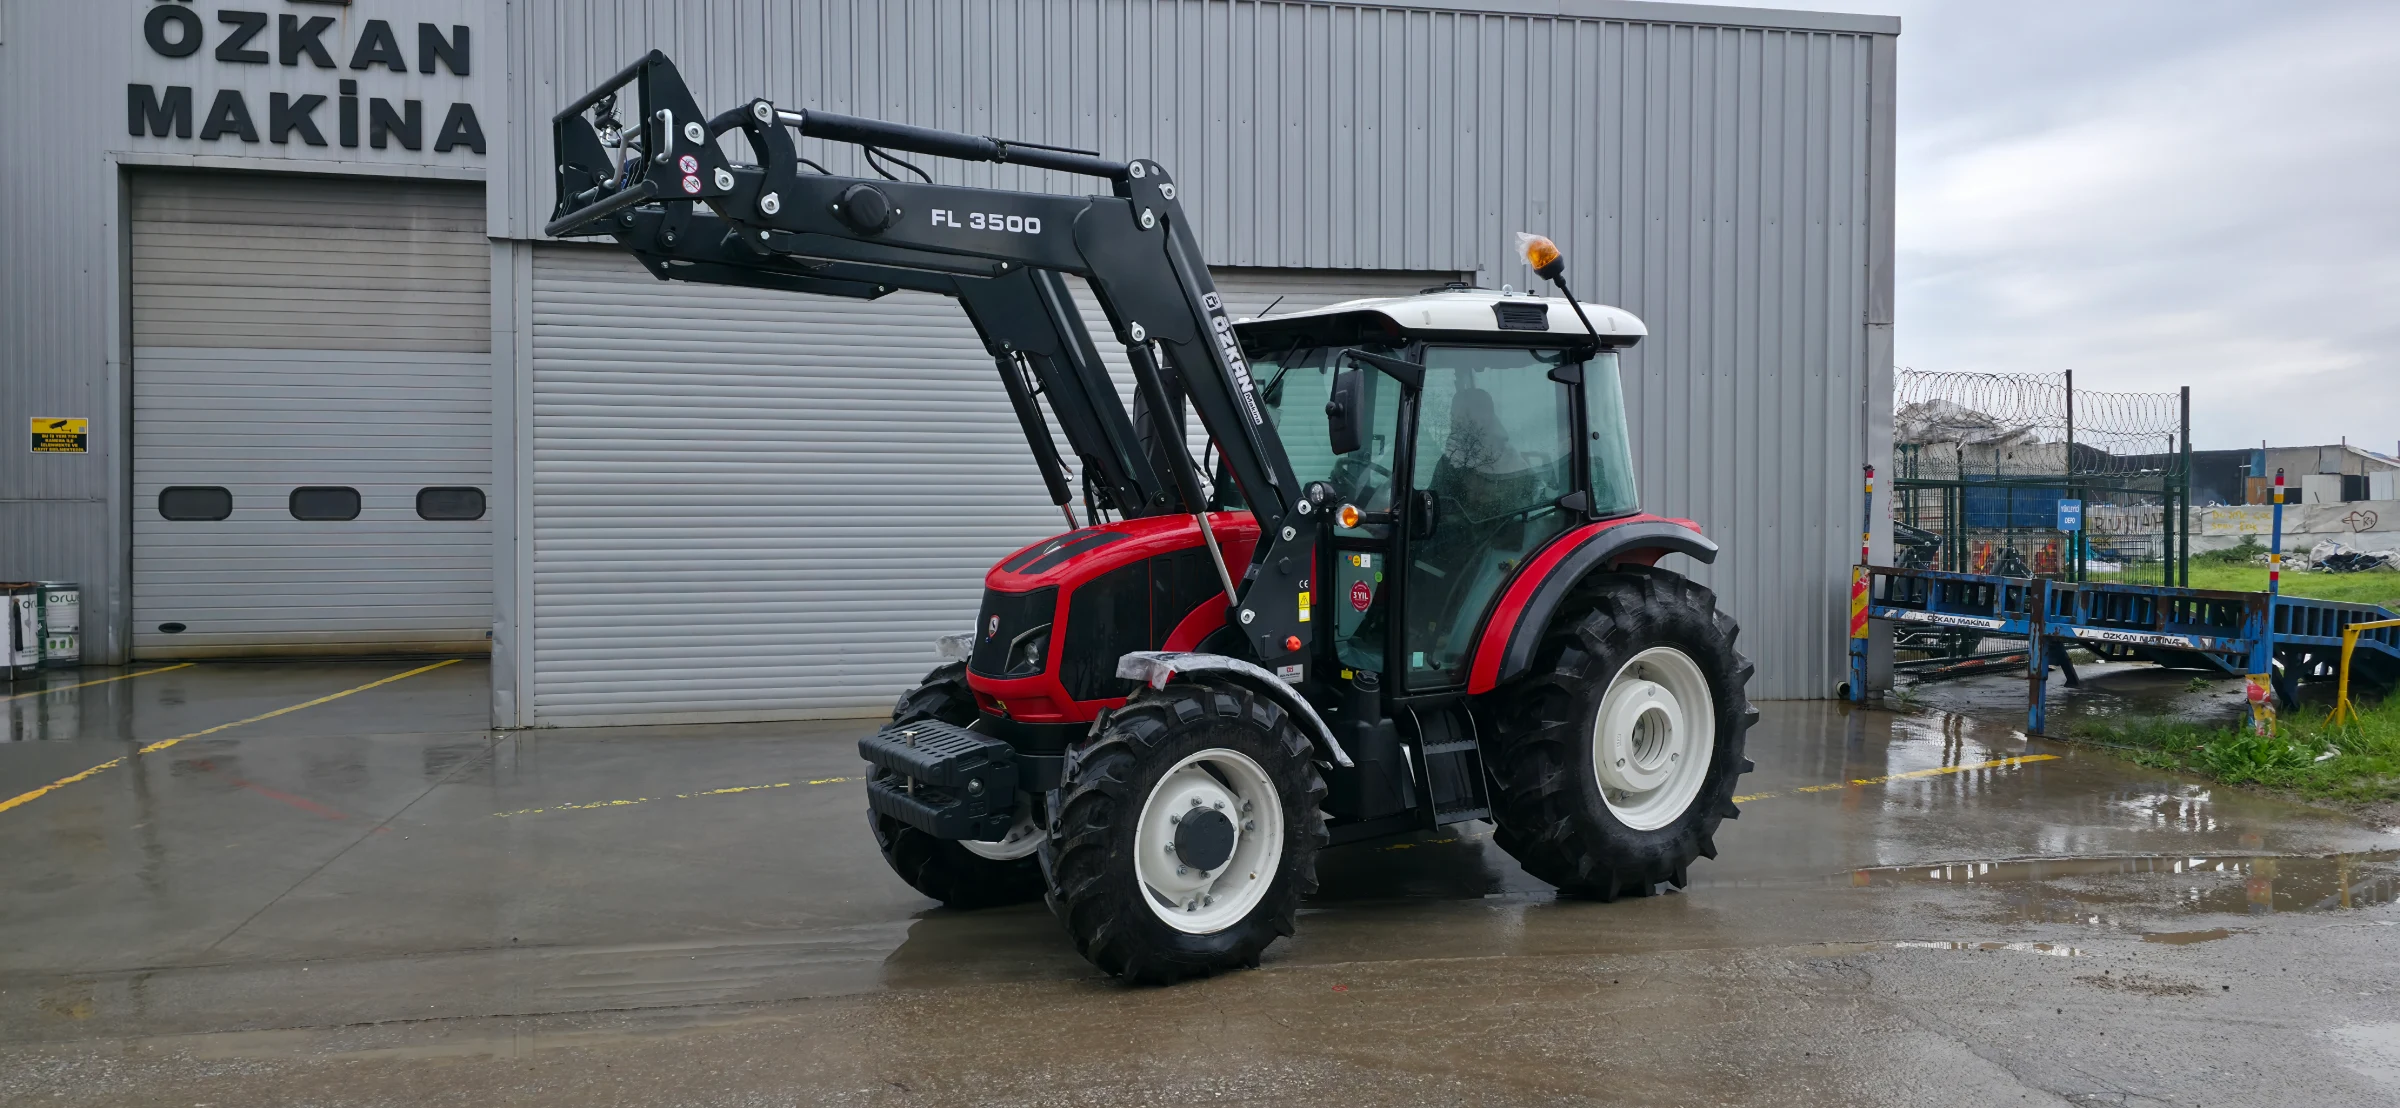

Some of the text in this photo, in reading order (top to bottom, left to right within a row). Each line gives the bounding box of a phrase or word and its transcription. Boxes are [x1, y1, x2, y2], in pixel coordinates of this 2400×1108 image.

[144, 0, 470, 76] ÖZKAN
[128, 79, 487, 154] MAKİNA
[932, 208, 1041, 234] FL 3500
[1212, 316, 1254, 393] ÖZKAN
[1245, 393, 1262, 425] Makina
[1353, 591, 1369, 600] 3 YIL
[1927, 614, 1956, 623] ÖZKAN
[2102, 632, 2137, 641] ÖZKAN
